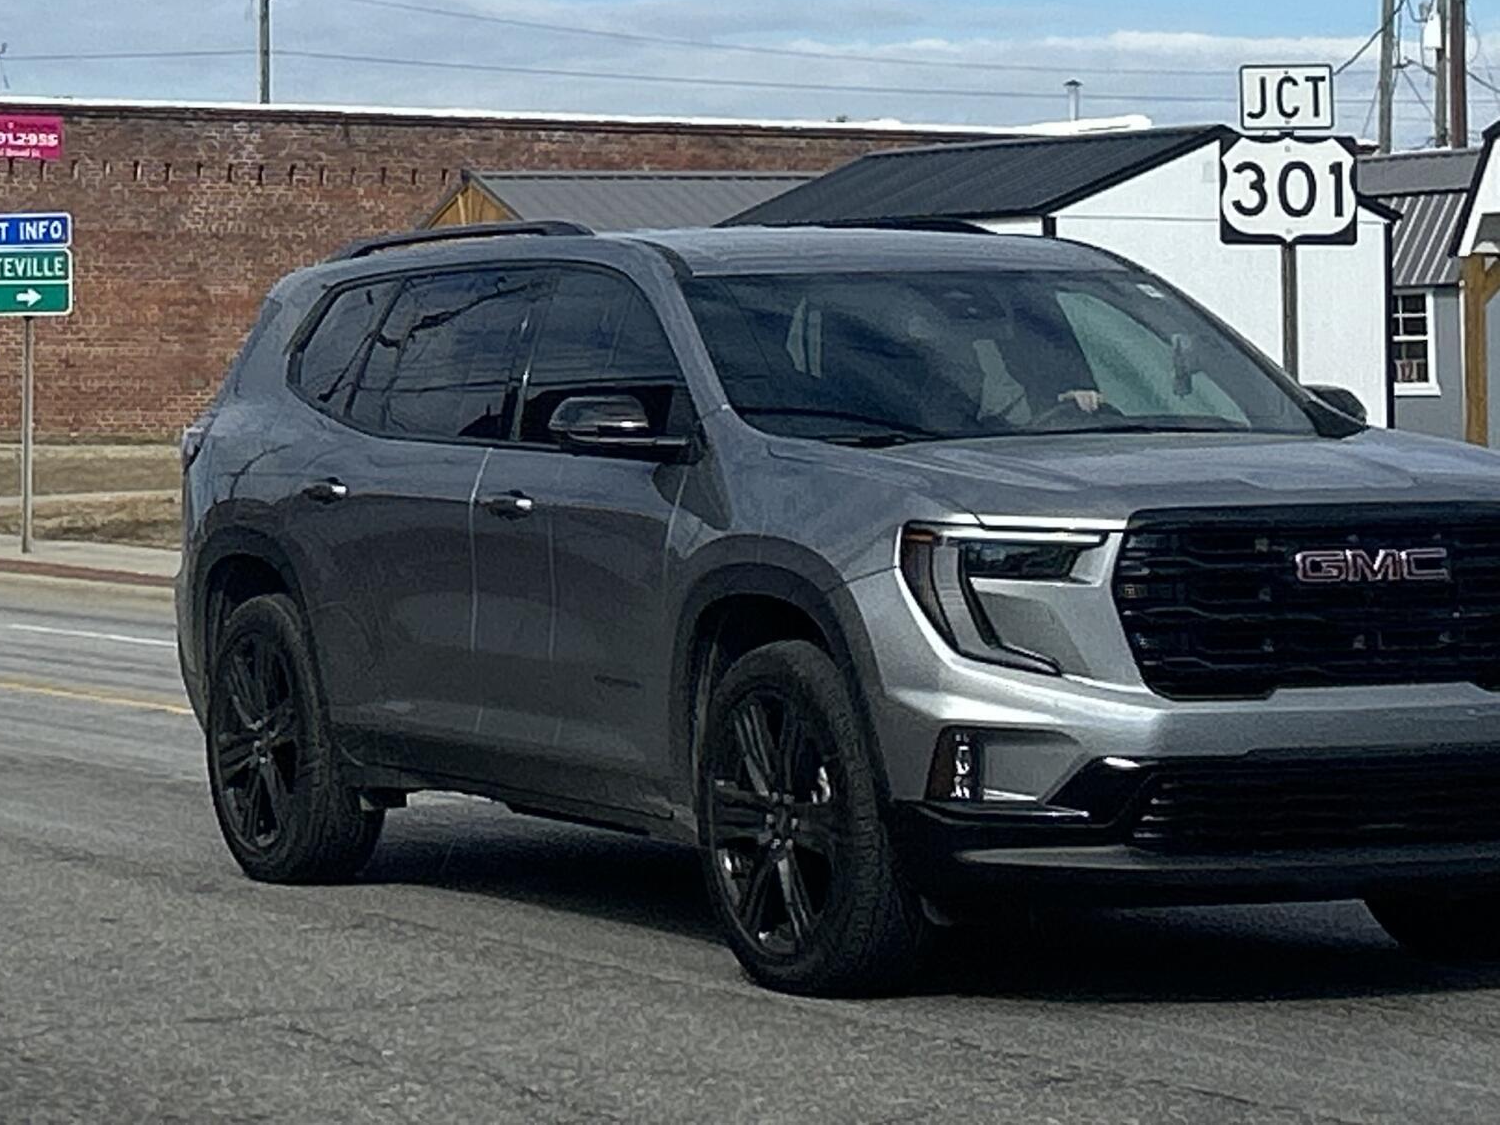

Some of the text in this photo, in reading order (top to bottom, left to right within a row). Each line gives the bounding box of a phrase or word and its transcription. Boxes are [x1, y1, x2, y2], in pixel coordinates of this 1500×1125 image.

[1246, 75, 1326, 119] JCT
[1231, 160, 1344, 218] 301
[19, 220, 63, 241] INFO
[1295, 547, 1449, 582] GMC
